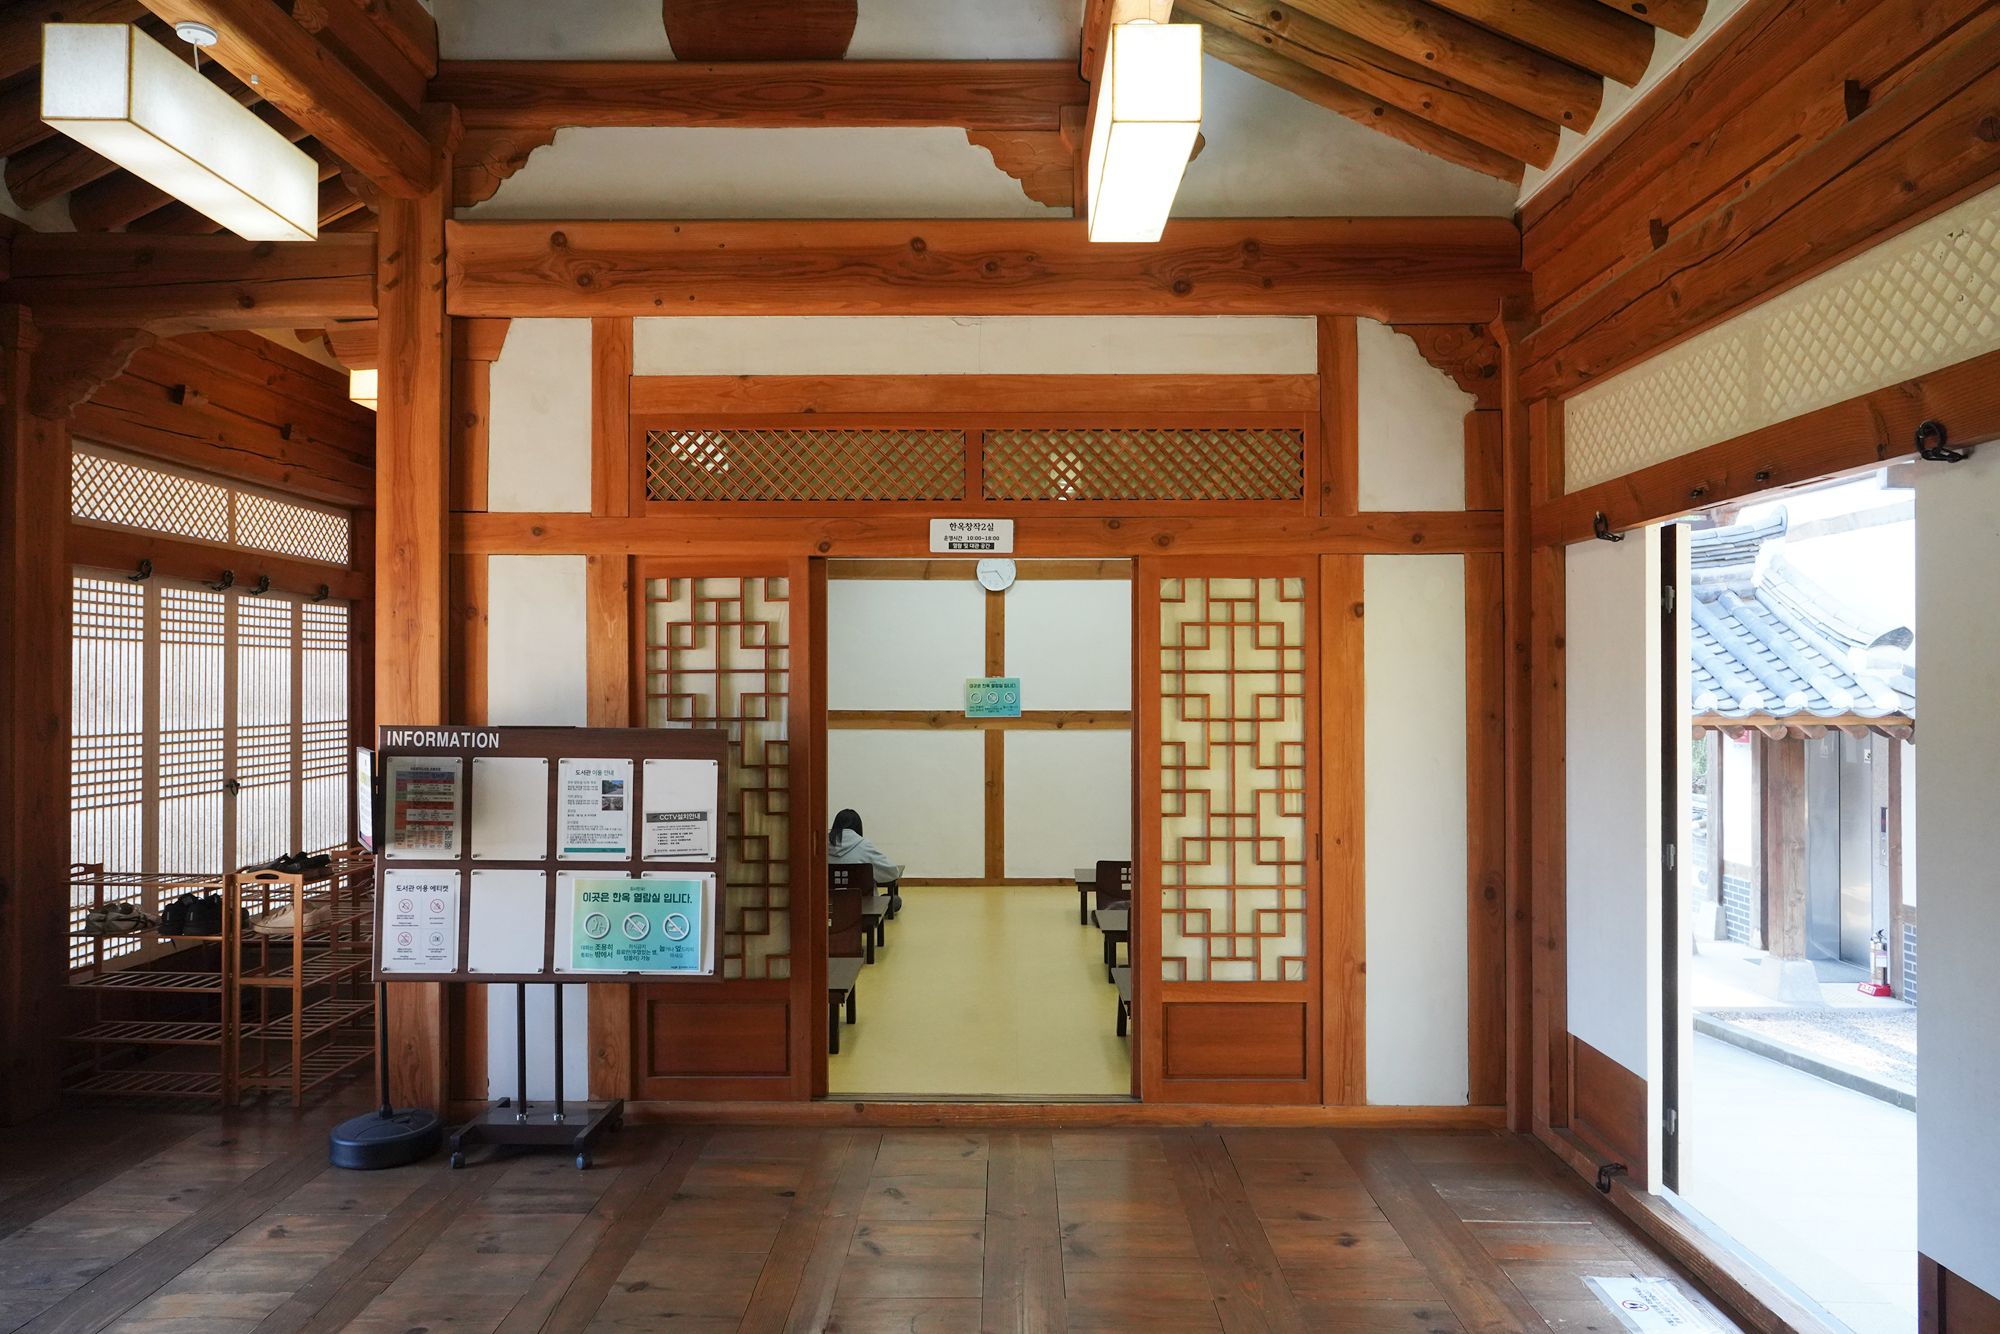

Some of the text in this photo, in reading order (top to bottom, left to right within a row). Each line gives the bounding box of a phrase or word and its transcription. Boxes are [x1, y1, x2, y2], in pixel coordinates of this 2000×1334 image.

[387, 730, 499, 748] INFORMATION
[582, 892, 692, 904] 이곳은 한옥 열람실 입니다.
